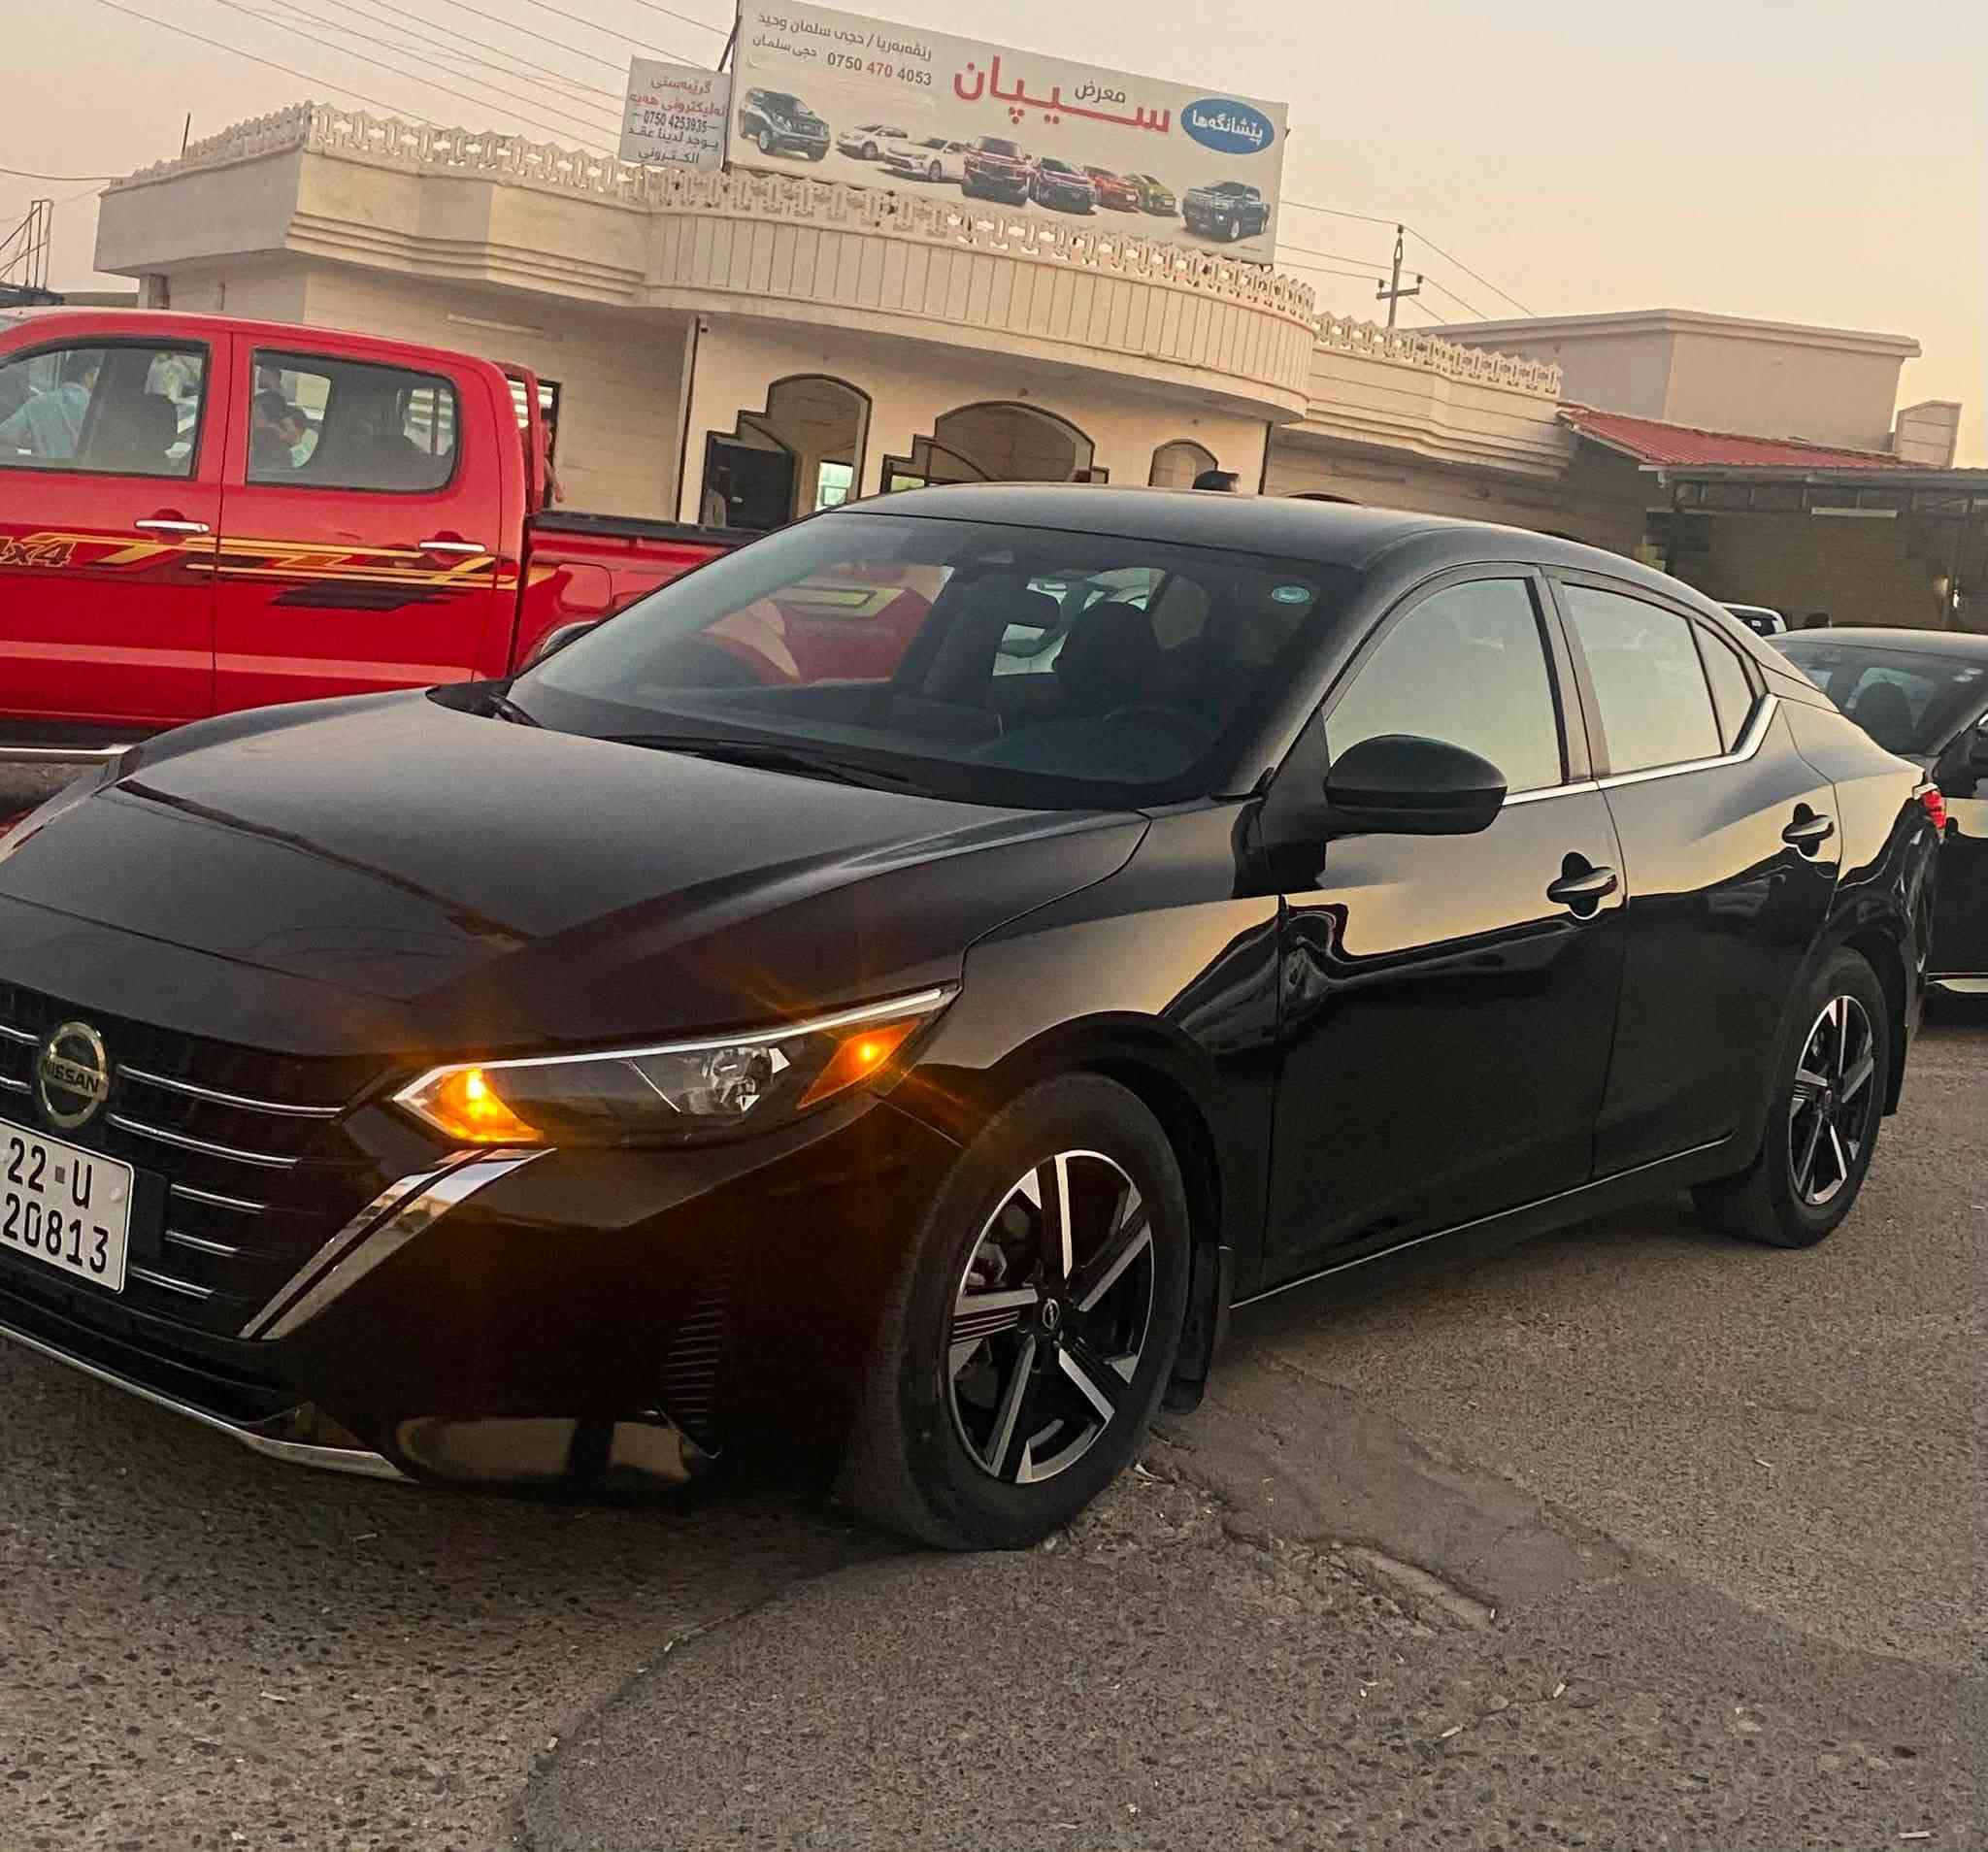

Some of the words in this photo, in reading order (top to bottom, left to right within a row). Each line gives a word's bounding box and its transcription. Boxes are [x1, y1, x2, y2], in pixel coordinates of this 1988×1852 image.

[790, 19, 831, 38] سلمان
[752, 34, 791, 52] سلمان
[827, 51, 863, 72] 0750
[866, 61, 893, 79] 470
[897, 67, 932, 86] 4053
[1075, 81, 1126, 104] معرض
[644, 110, 667, 126] 0750
[46, 1060, 99, 1094] NISSAN
[7, 1137, 47, 1193] 22
[72, 1159, 93, 1209] U
[3, 1193, 109, 1274] 20813
